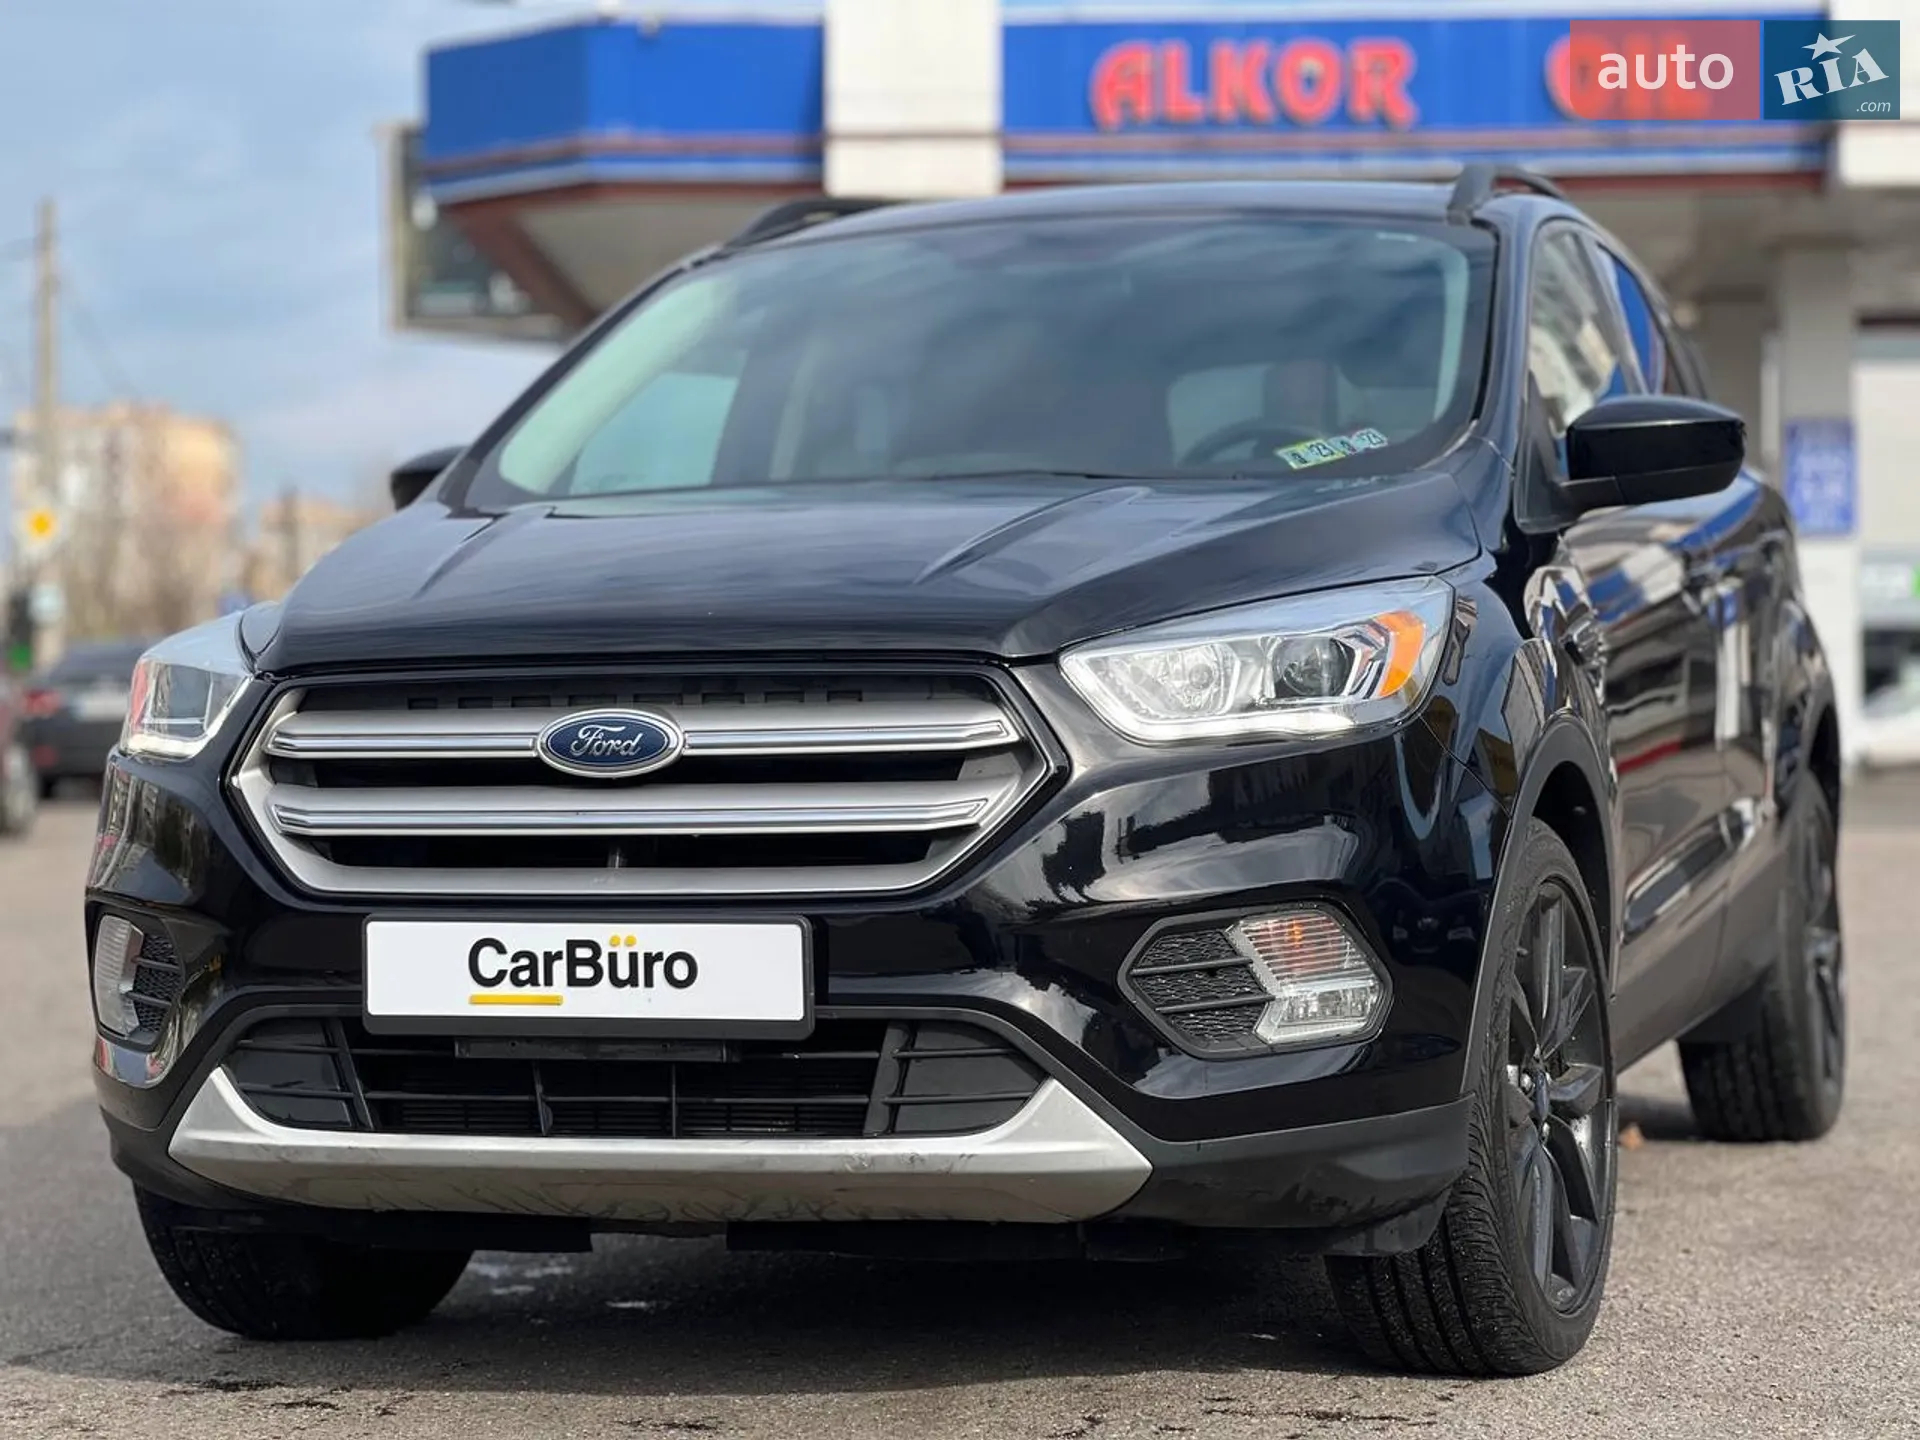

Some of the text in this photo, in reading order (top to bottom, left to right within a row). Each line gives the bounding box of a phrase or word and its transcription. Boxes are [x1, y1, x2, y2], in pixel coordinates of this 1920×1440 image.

[1092, 38, 1418, 130] ALKOR
[570, 724, 643, 756] Ford
[468, 935, 698, 989] CarBüro
